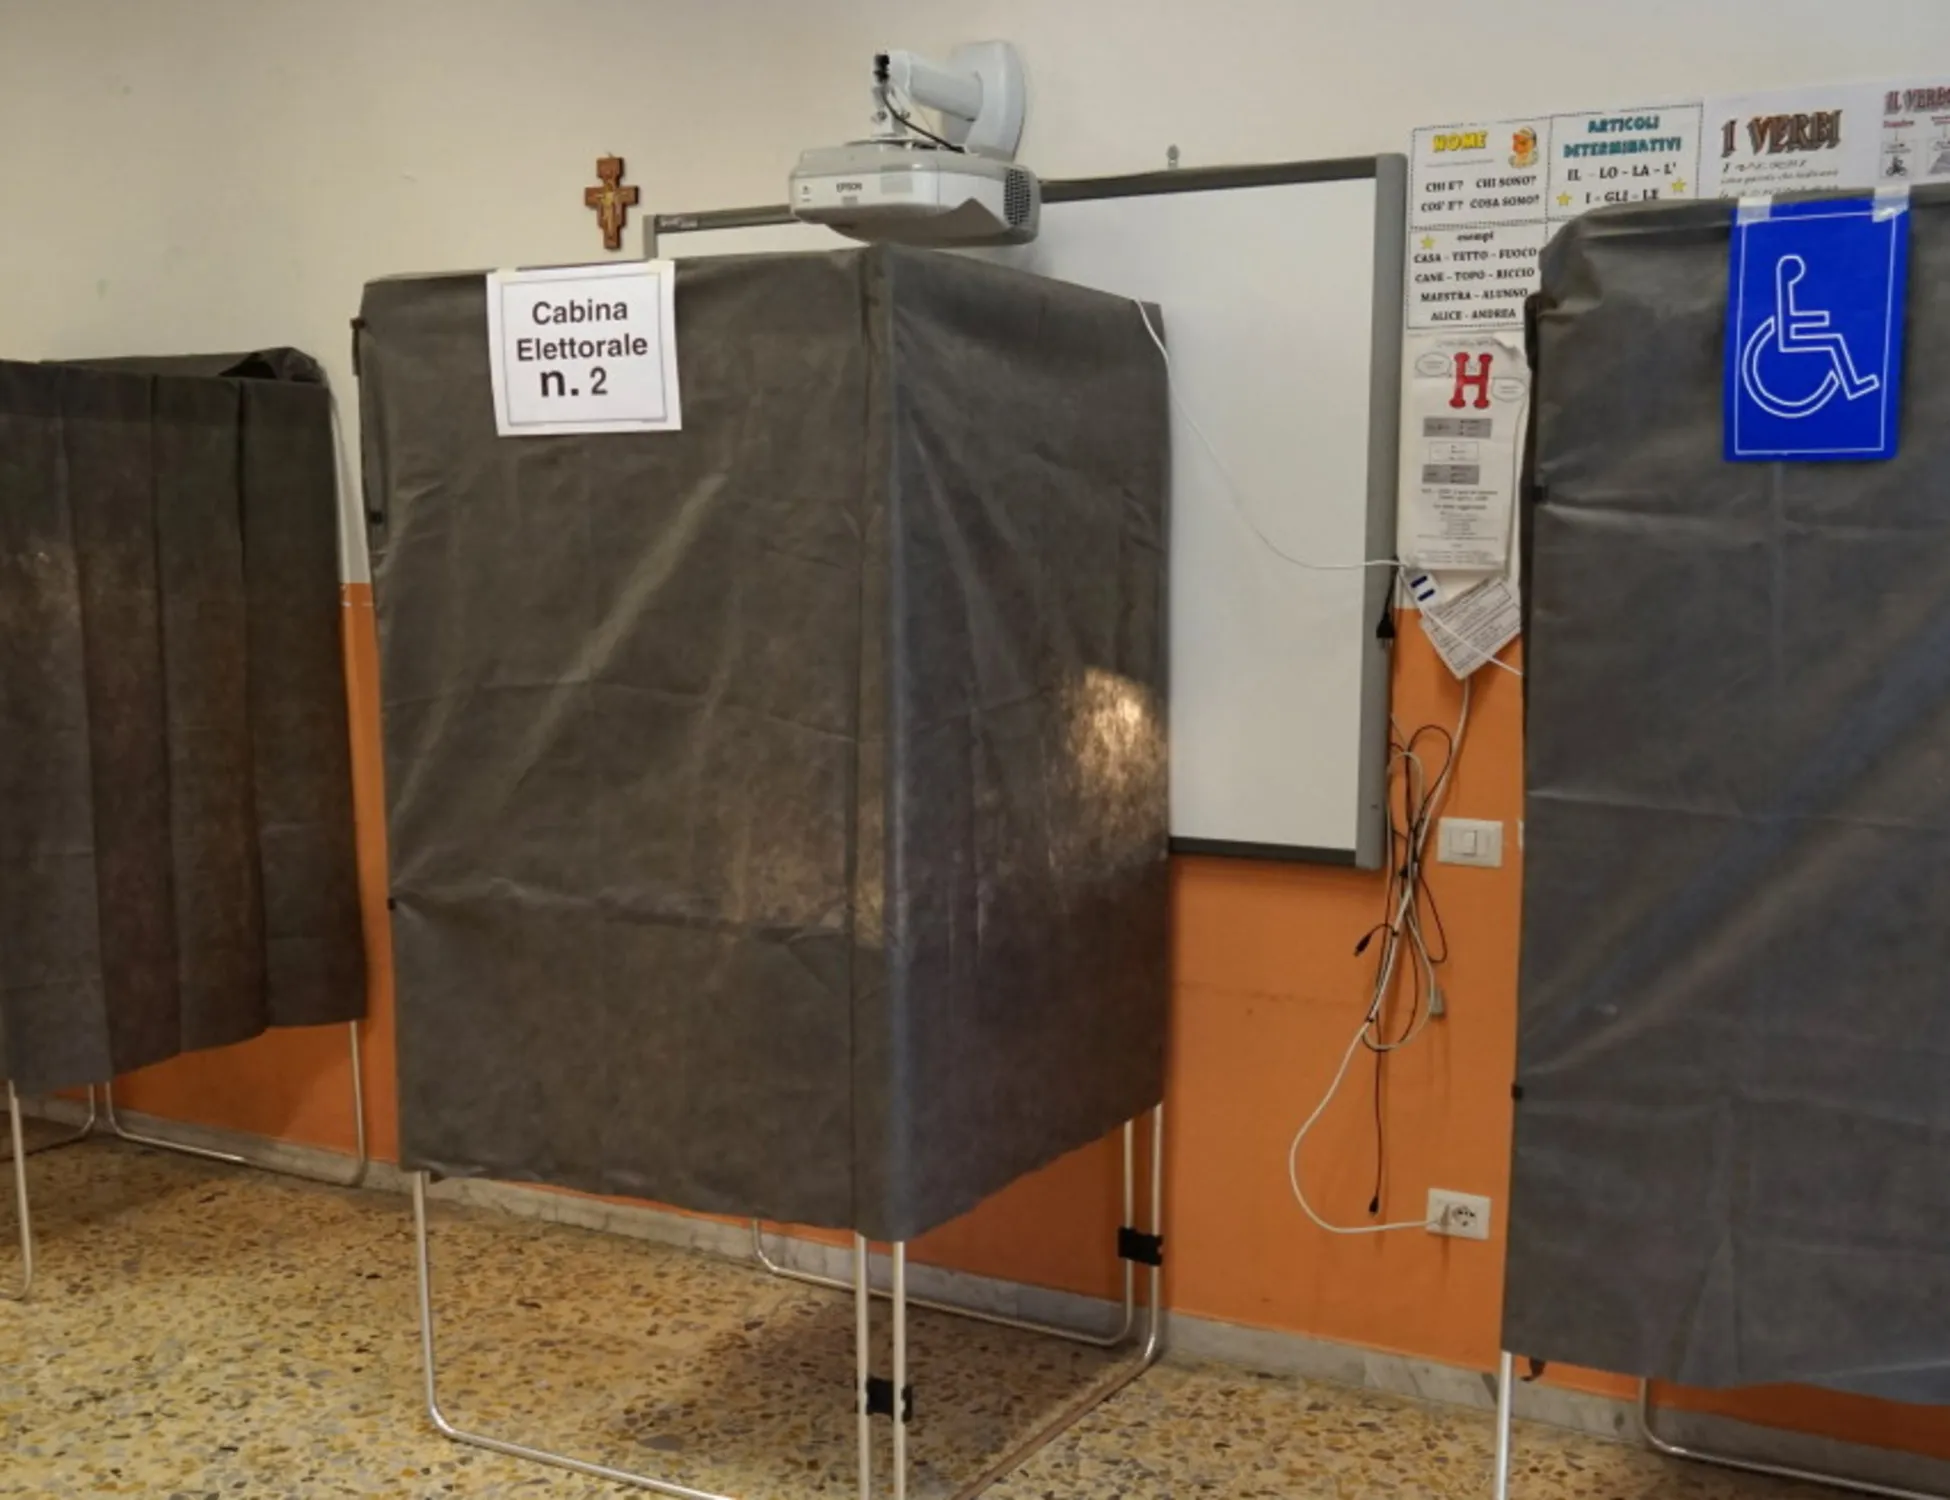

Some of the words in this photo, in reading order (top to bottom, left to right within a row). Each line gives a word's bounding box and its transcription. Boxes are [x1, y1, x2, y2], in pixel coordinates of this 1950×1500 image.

[1588, 116, 1660, 133] ARTICOLI
[1433, 132, 1488, 152] NOME
[1720, 119, 1737, 158] I
[1747, 109, 1843, 155] VERBI
[1563, 136, 1681, 158] DETERMINATIVI
[1599, 166, 1618, 179] LO
[1632, 164, 1649, 177] LA
[1664, 162, 1676, 175] L'
[1425, 182, 1445, 193] CHI
[1476, 178, 1496, 189] CHI
[1469, 198, 1499, 209] COSA
[1604, 190, 1628, 203] GLI
[1643, 188, 1659, 201] LE
[1413, 253, 1442, 264] CASA
[1452, 250, 1489, 262] TETTO
[1499, 247, 1537, 259] FUOCO
[1414, 272, 1444, 283] CANE
[1454, 270, 1485, 281] TOPO
[1496, 267, 1535, 279] RICCIO
[1420, 291, 1472, 302] MAESTRA
[1482, 288, 1528, 300] ALUNNO
[531, 299, 628, 326] Cabina
[1430, 310, 1462, 321] ALICE
[1471, 308, 1516, 319] ANDREA
[516, 333, 648, 362] Elettorale
[540, 370, 579, 398] n.
[590, 367, 607, 395] 2
[1448, 351, 1494, 410] H
